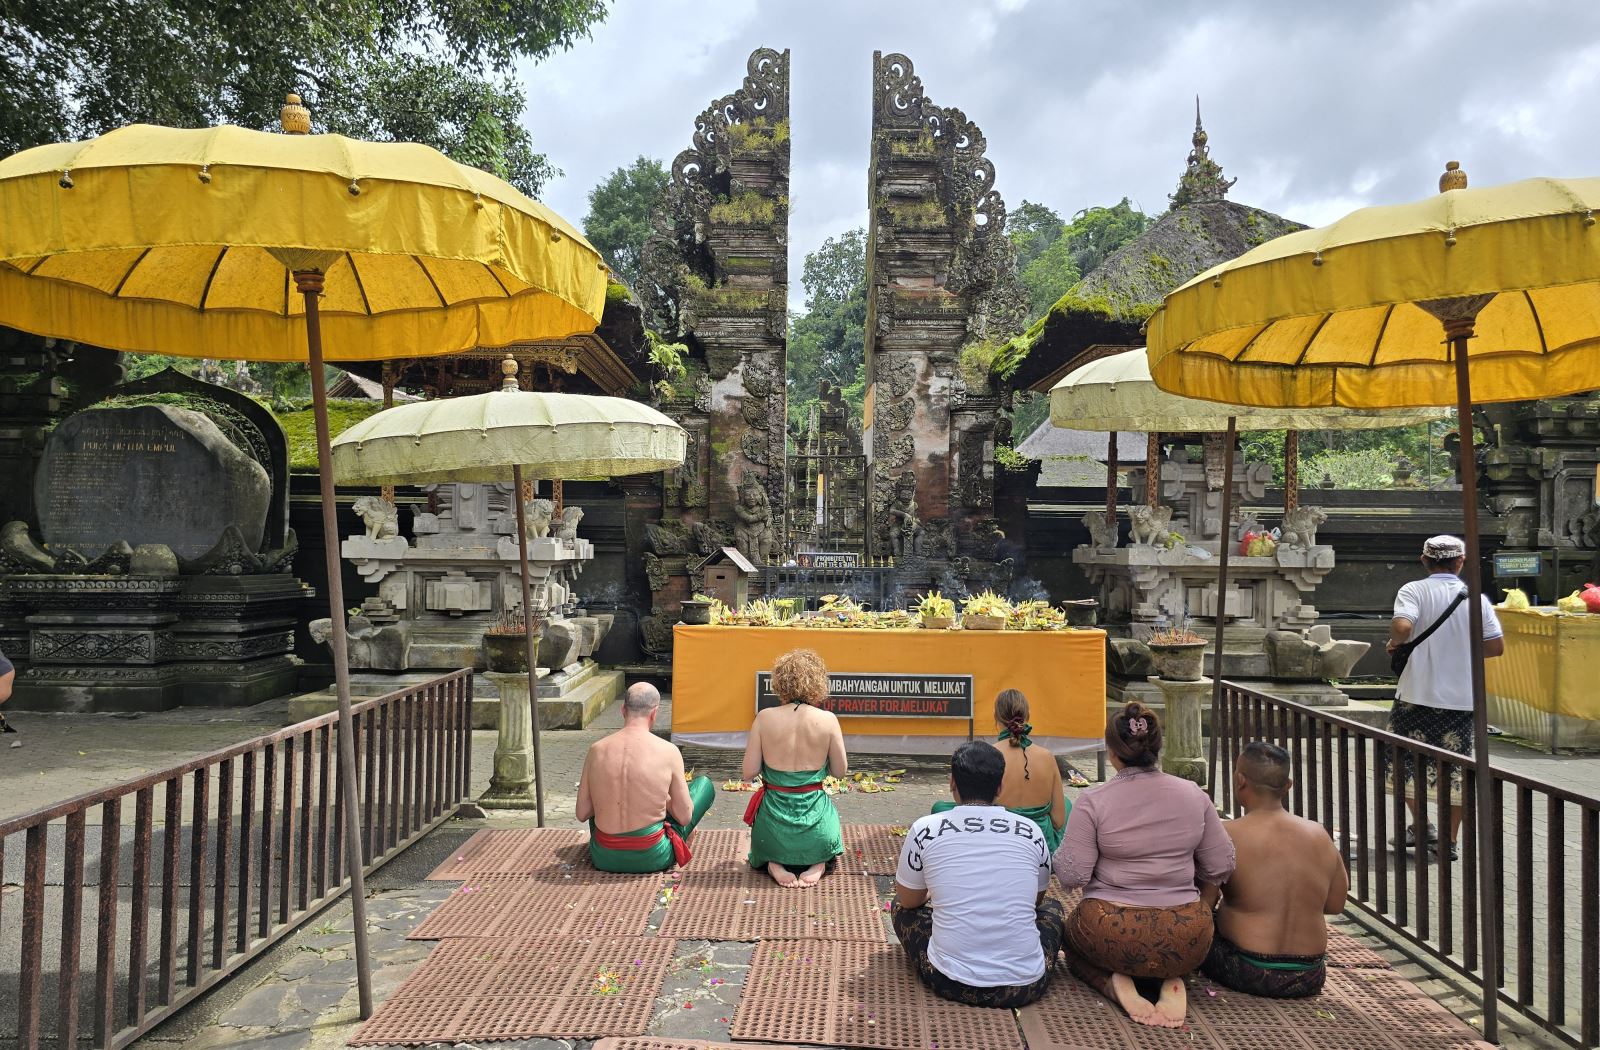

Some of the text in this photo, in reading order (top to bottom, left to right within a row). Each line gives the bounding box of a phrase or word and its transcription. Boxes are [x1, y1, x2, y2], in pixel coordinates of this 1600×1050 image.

[828, 679, 966, 694] MBAHYANGAN UNTUK MELUKAT
[824, 698, 949, 713] OF PRAYER FOR MELUKAT
